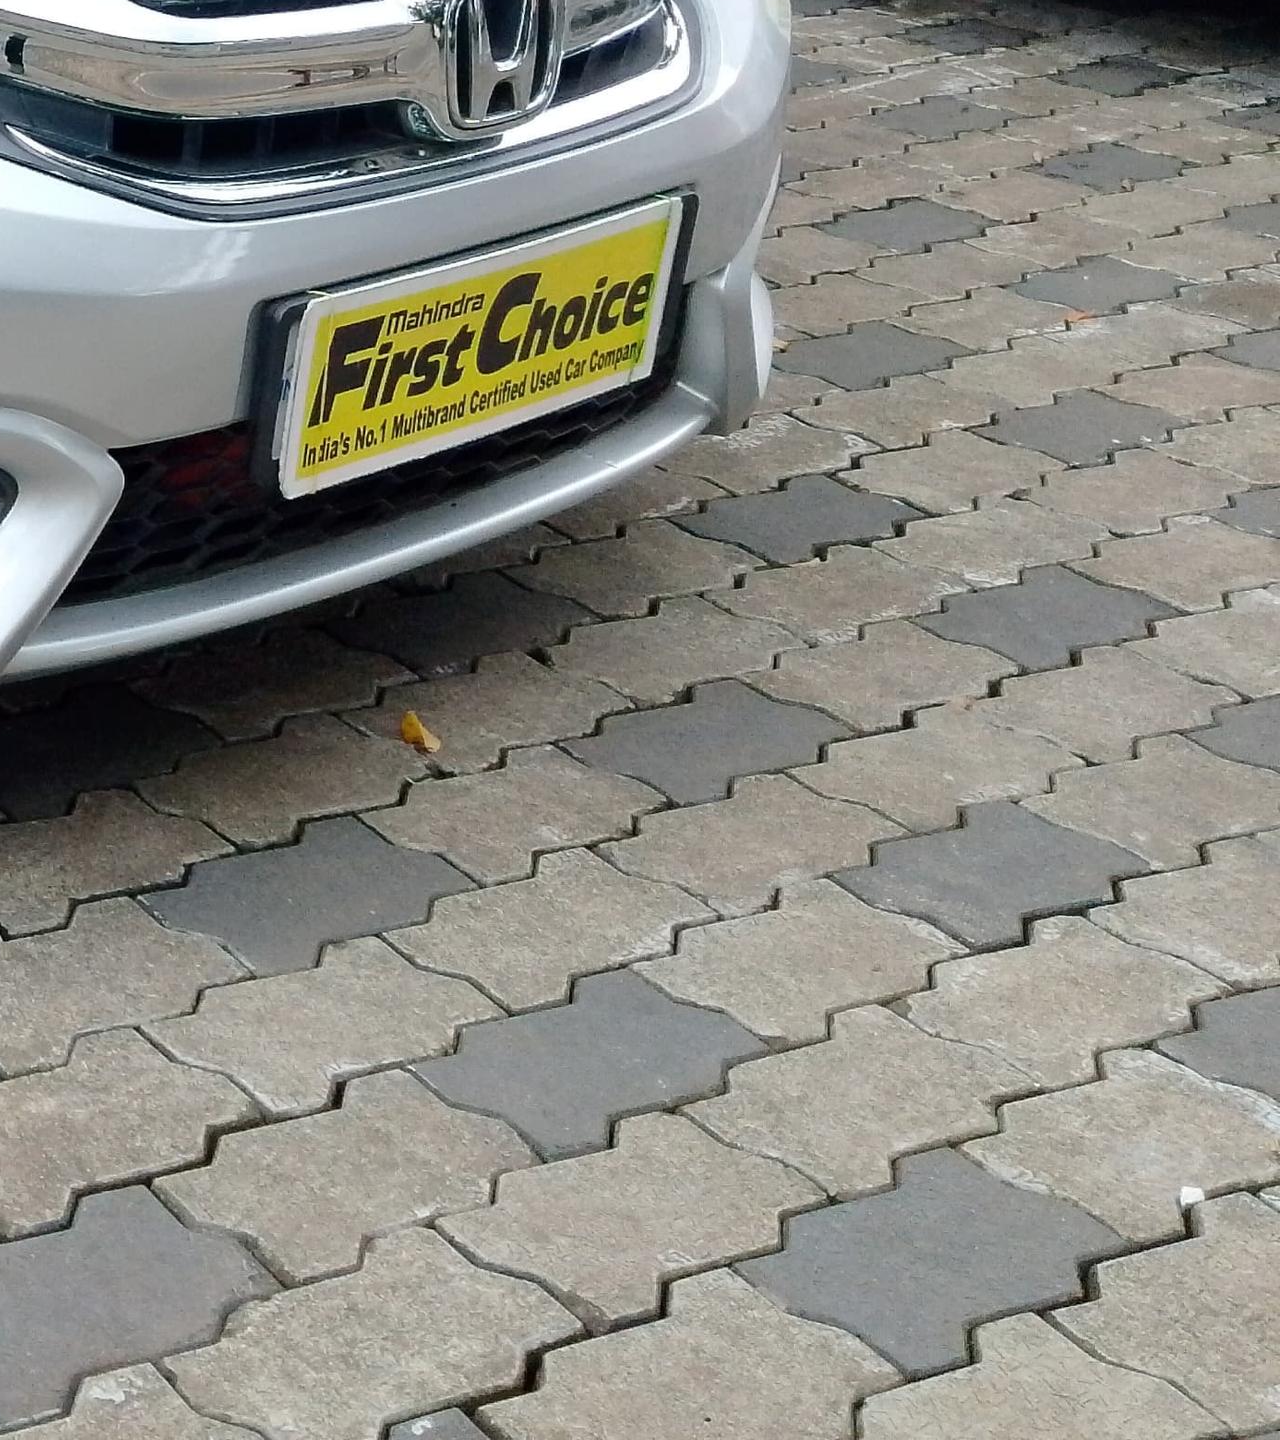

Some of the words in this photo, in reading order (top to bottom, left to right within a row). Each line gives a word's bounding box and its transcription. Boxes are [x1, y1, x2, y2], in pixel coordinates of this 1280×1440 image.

[307, 315, 476, 428] First
[476, 272, 655, 375] Choice
[386, 293, 485, 336] Mahindra
[302, 432, 350, 468] India's
[391, 394, 467, 440] Multibrand
[469, 379, 527, 415] Certified
[530, 363, 561, 394] Used
[565, 357, 587, 381] Car
[589, 338, 645, 373] Company
